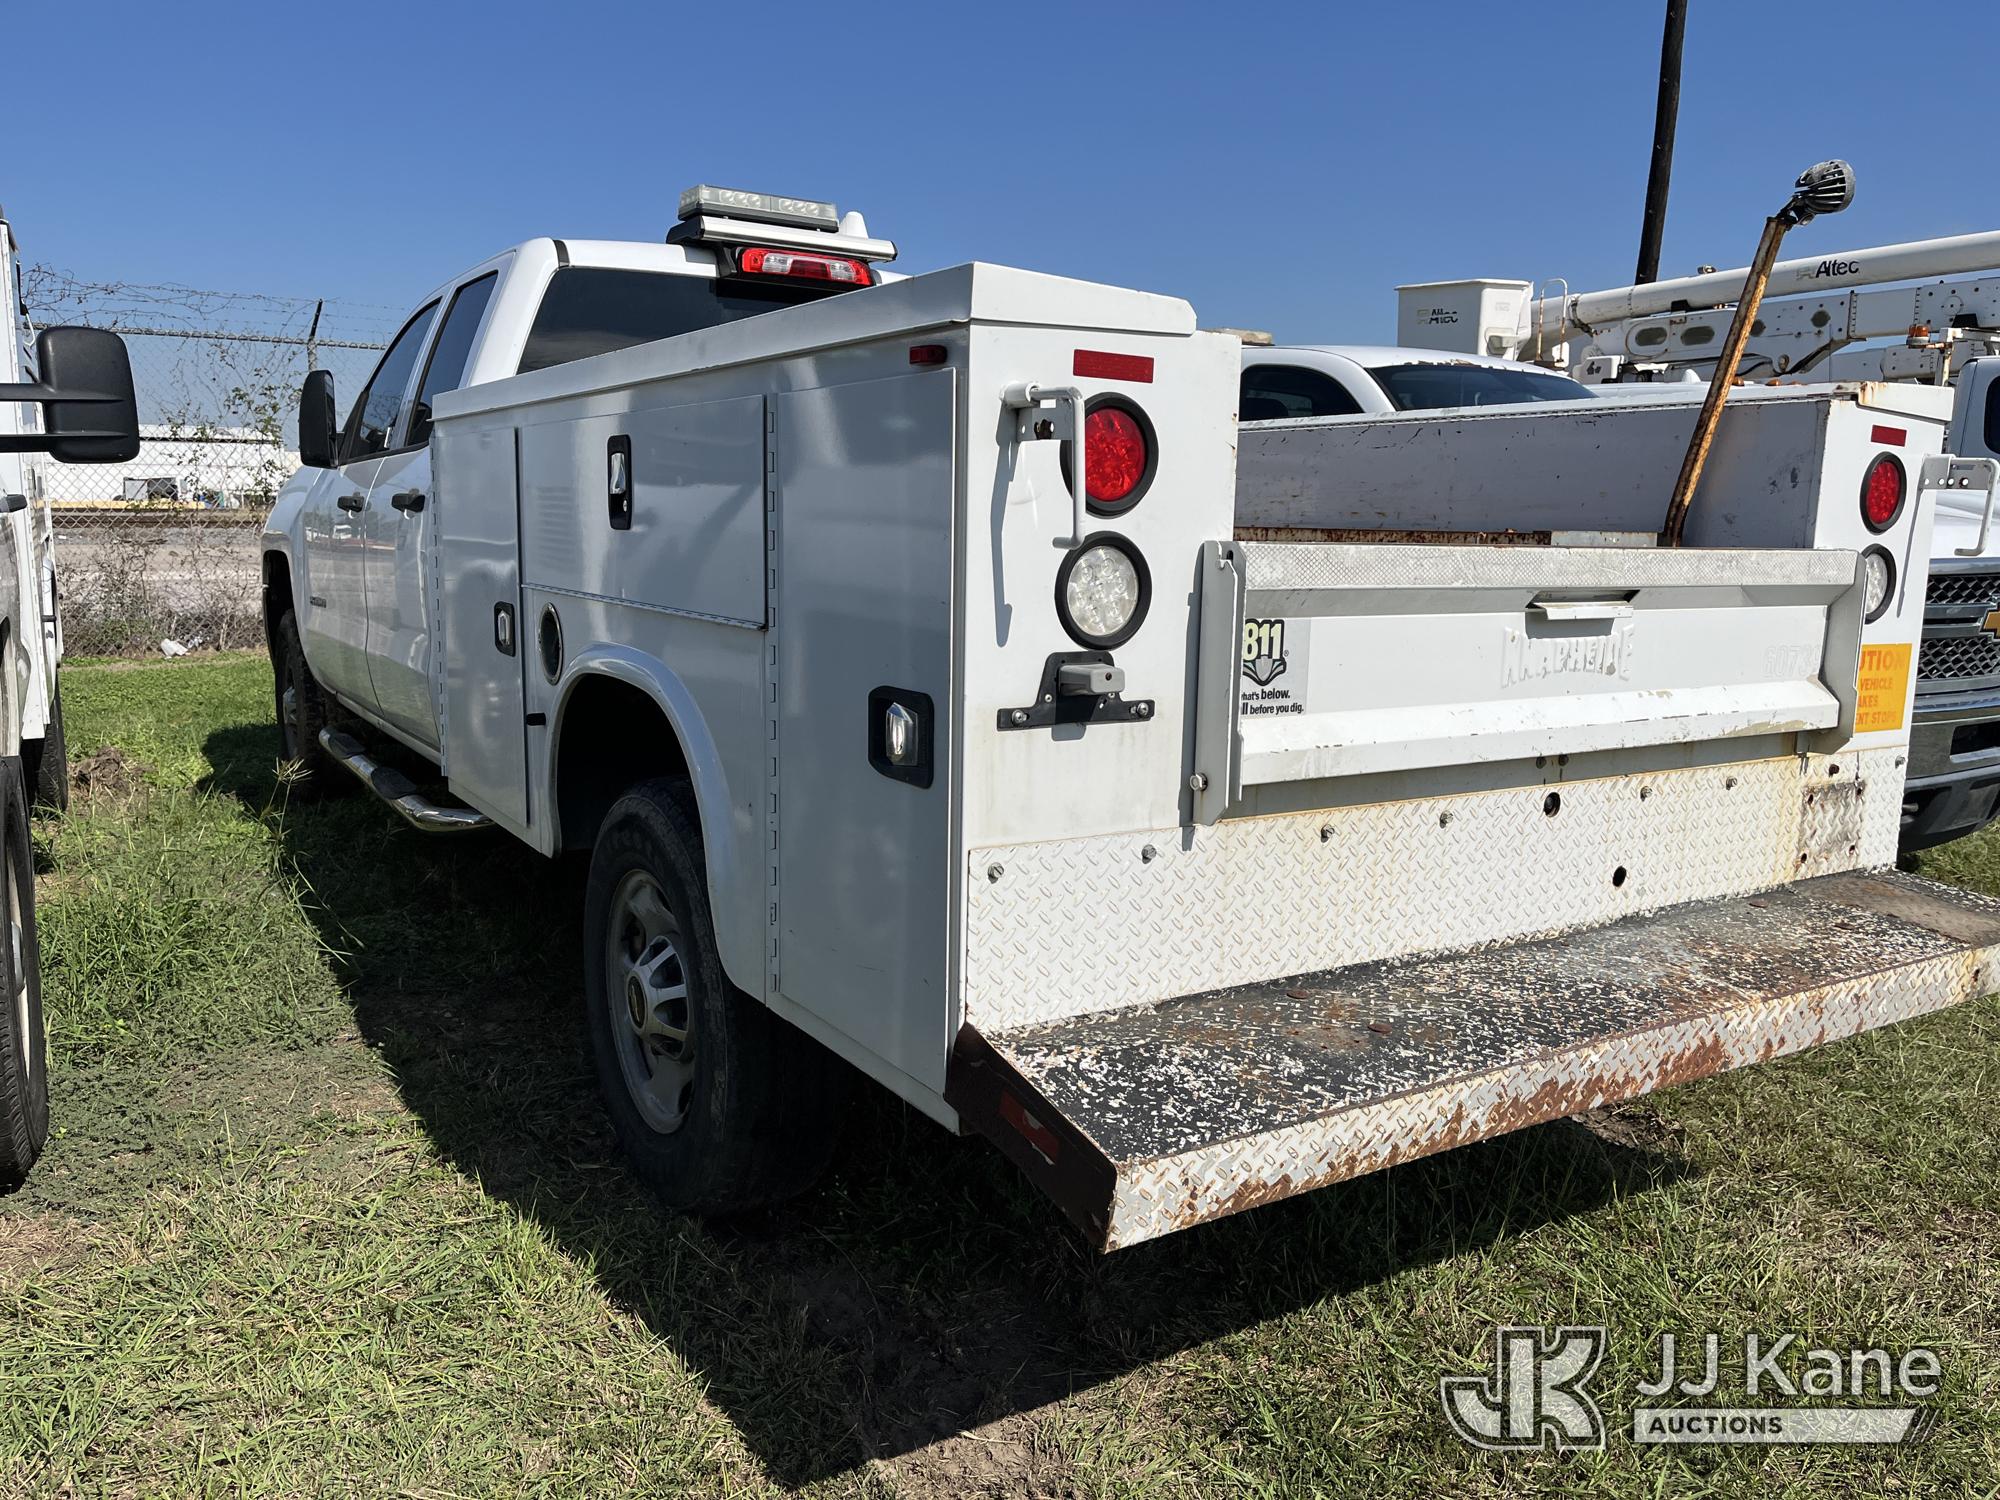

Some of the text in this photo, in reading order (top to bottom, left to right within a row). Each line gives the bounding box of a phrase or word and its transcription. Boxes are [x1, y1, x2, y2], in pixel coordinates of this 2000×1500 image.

[1815, 259, 1860, 278] Altec
[1242, 619, 1284, 661] 811
[1860, 678, 1893, 691] VEHICLE
[1261, 688, 1291, 700] below.
[1250, 704, 1275, 715] before
[1276, 704, 1290, 715] you
[1290, 702, 1304, 714] dig.
